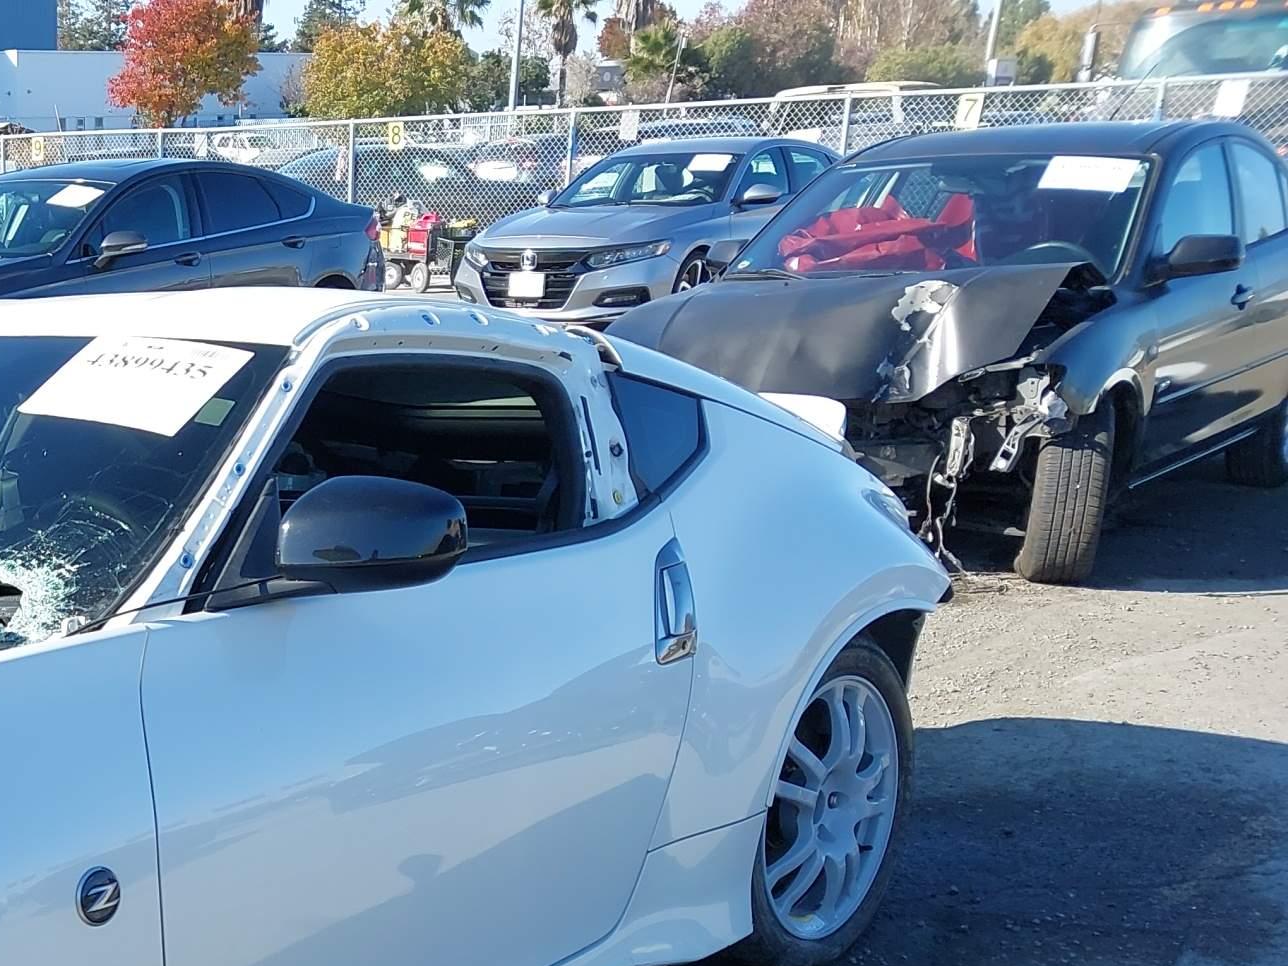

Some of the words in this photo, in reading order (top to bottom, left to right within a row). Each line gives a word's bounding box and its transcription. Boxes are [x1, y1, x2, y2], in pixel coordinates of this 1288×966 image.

[964, 98, 979, 121] 7
[392, 125, 400, 144] 8
[35, 140, 41, 156] 9
[87, 353, 213, 379] 43899435
